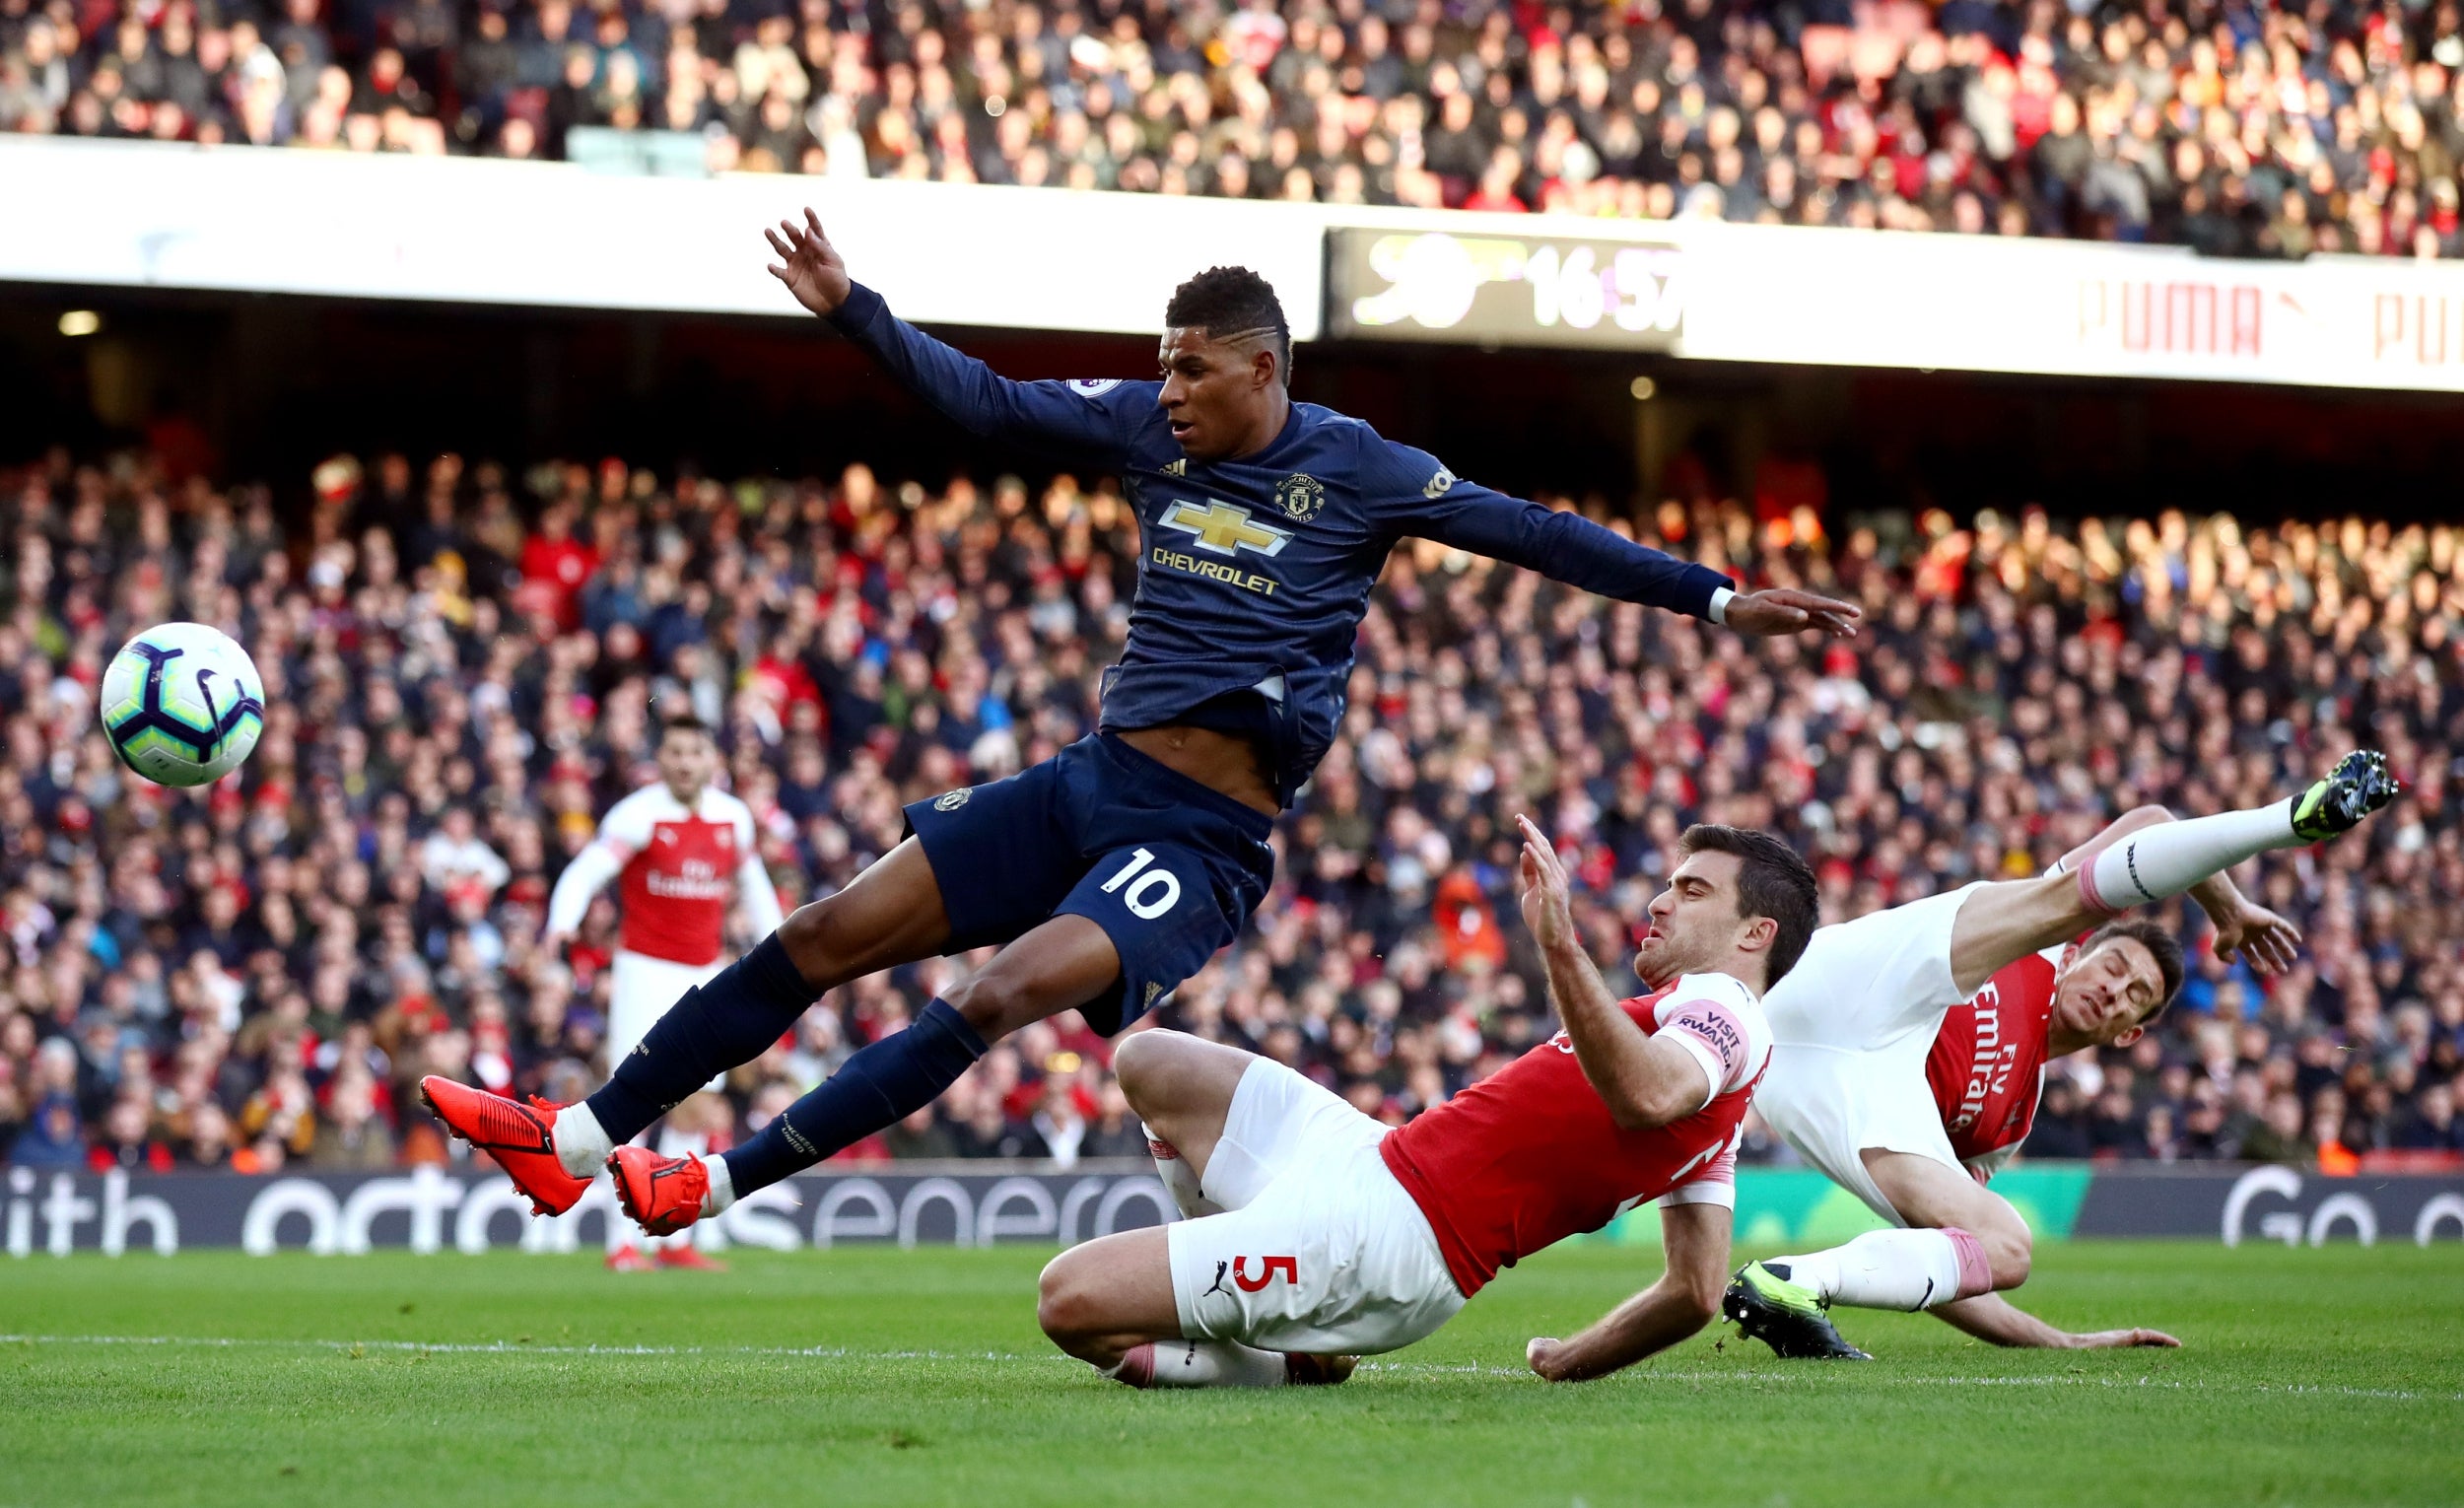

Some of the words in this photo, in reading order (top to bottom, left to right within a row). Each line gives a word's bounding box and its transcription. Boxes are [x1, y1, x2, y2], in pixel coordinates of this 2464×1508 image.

[2078, 280, 2263, 357] PUMA
[2373, 293, 2464, 365] PU
[1152, 547, 1279, 596] CHEVROLET
[1100, 847, 1181, 920] 10
[1707, 1010, 1741, 1049] VISIT
[1990, 1043, 2018, 1095] Fly
[0, 1166, 180, 1257] ith
[1233, 1255, 1298, 1293] 5
